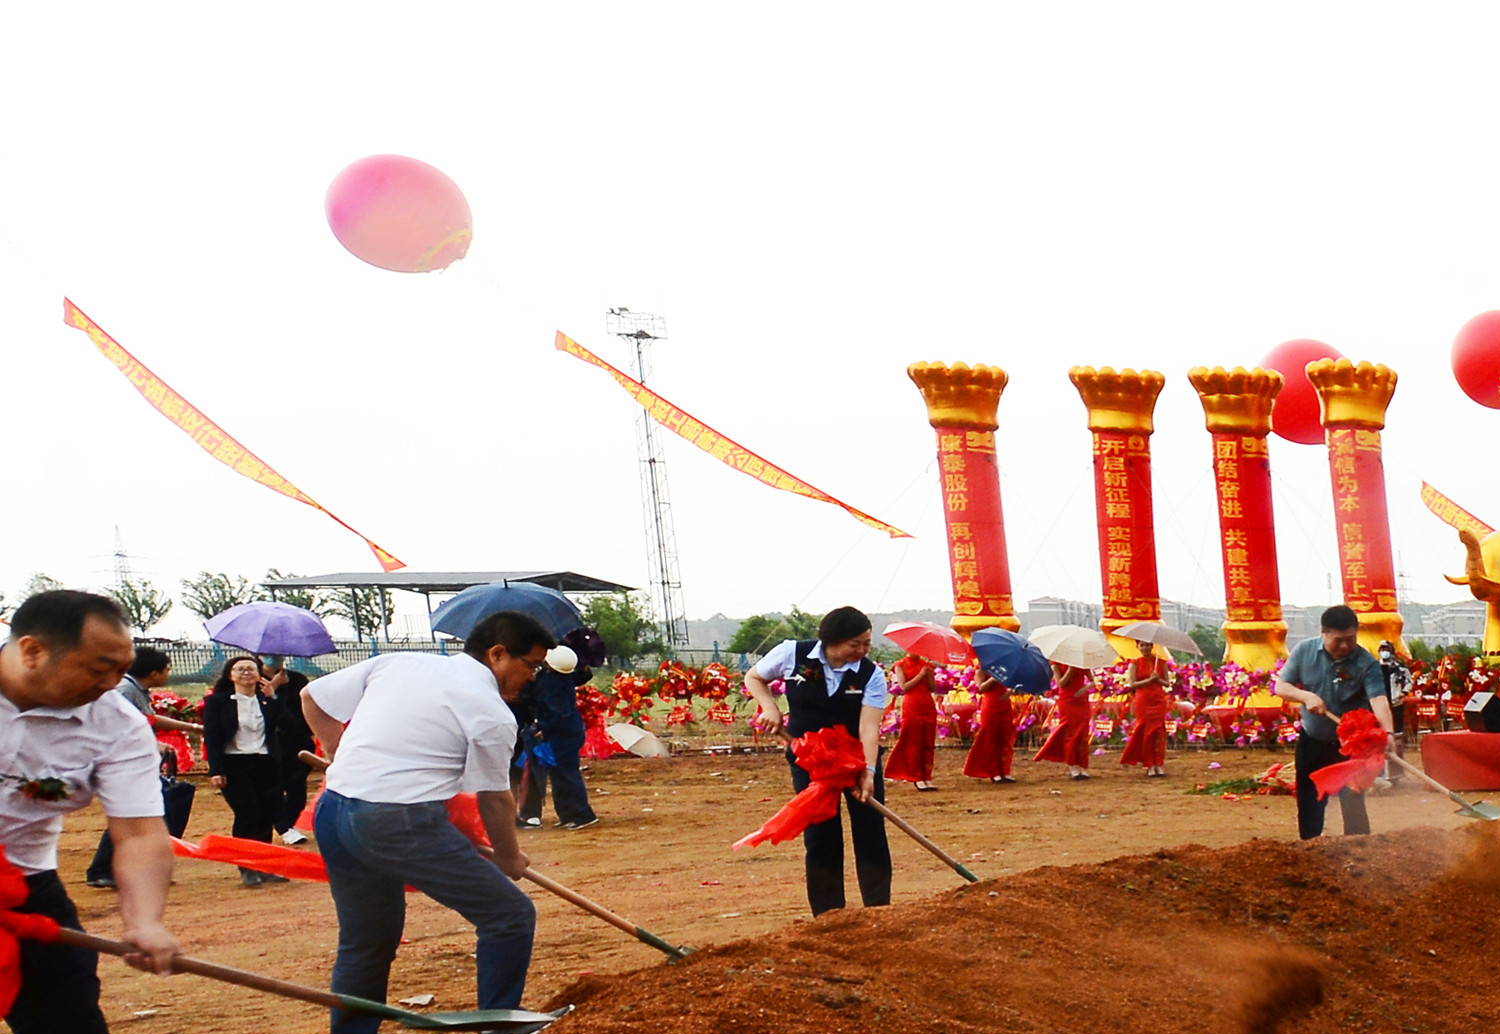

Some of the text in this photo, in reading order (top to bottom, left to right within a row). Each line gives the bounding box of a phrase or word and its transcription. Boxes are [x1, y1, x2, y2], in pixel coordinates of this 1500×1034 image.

[941, 434, 981, 598] 康泰股份 再创辉煌
[1101, 440, 1132, 602] 开启新征程 实现新跨越
[1216, 441, 1254, 604] 团结奋进 共建共享
